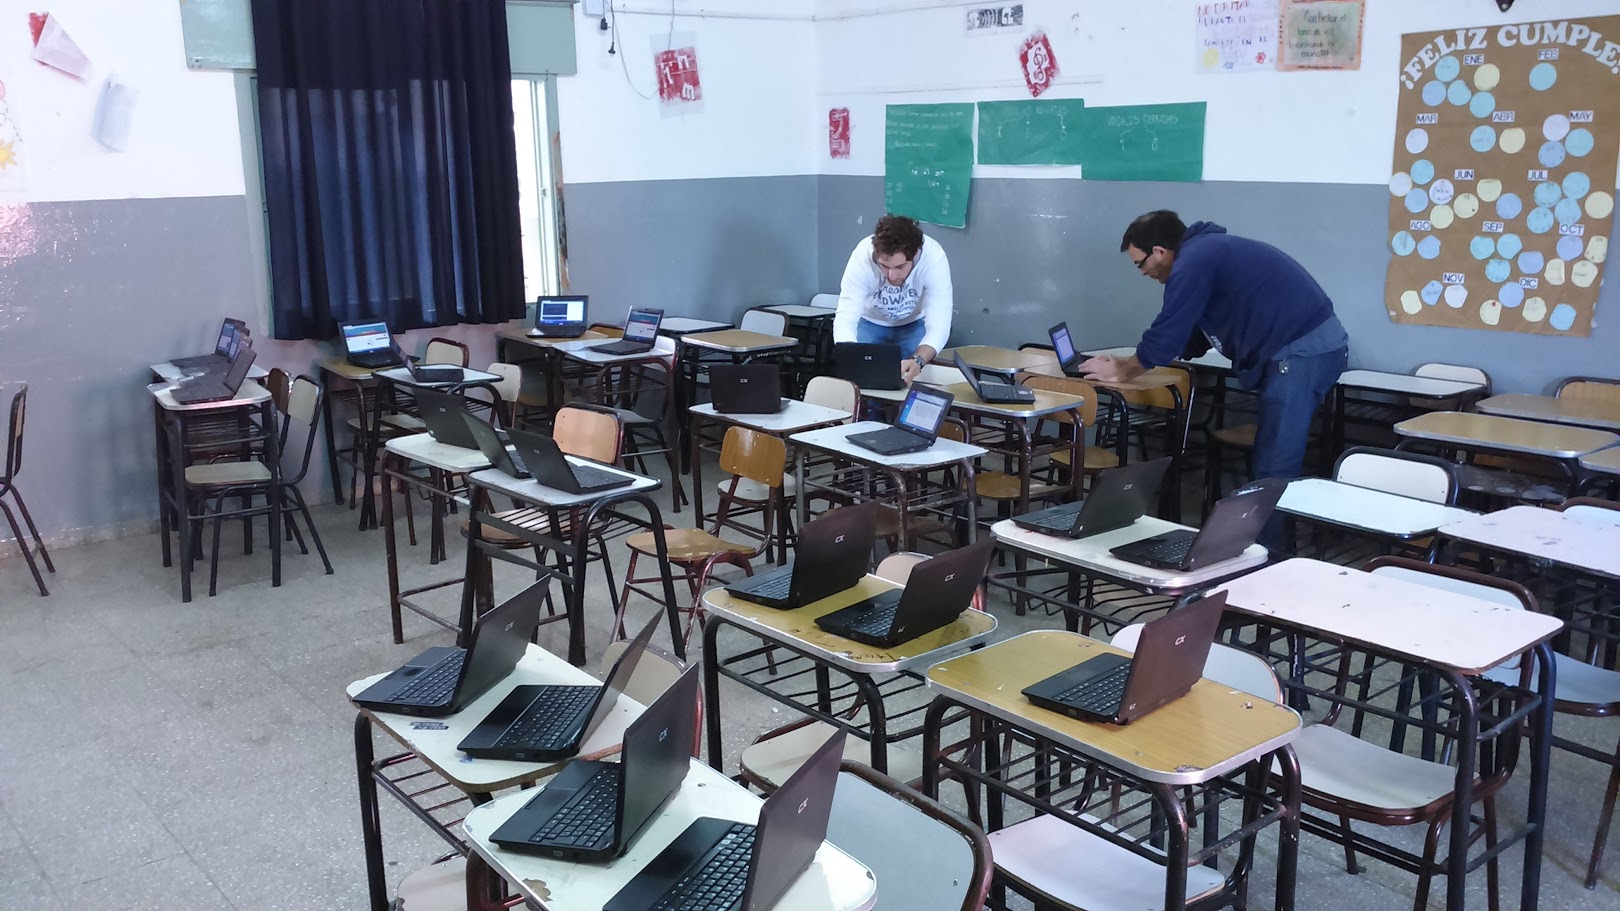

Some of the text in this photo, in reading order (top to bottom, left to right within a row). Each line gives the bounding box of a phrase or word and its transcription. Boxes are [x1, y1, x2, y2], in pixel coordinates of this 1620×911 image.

[1400, 28, 1488, 90] ¡FELIZ
[1464, 50, 1558, 65] ENE FEB
[1417, 111, 1593, 123] MAR ABR MAY
[1455, 170, 1547, 180] JUN JUL
[1411, 221, 1583, 234] AGO SEP OCT
[1444, 273, 1537, 288] NOV DIC
[835, 534, 845, 544] CX
[945, 573, 956, 582] CX
[1174, 635, 1186, 646] CX
[659, 728, 669, 742] CX
[798, 797, 809, 815] CX
